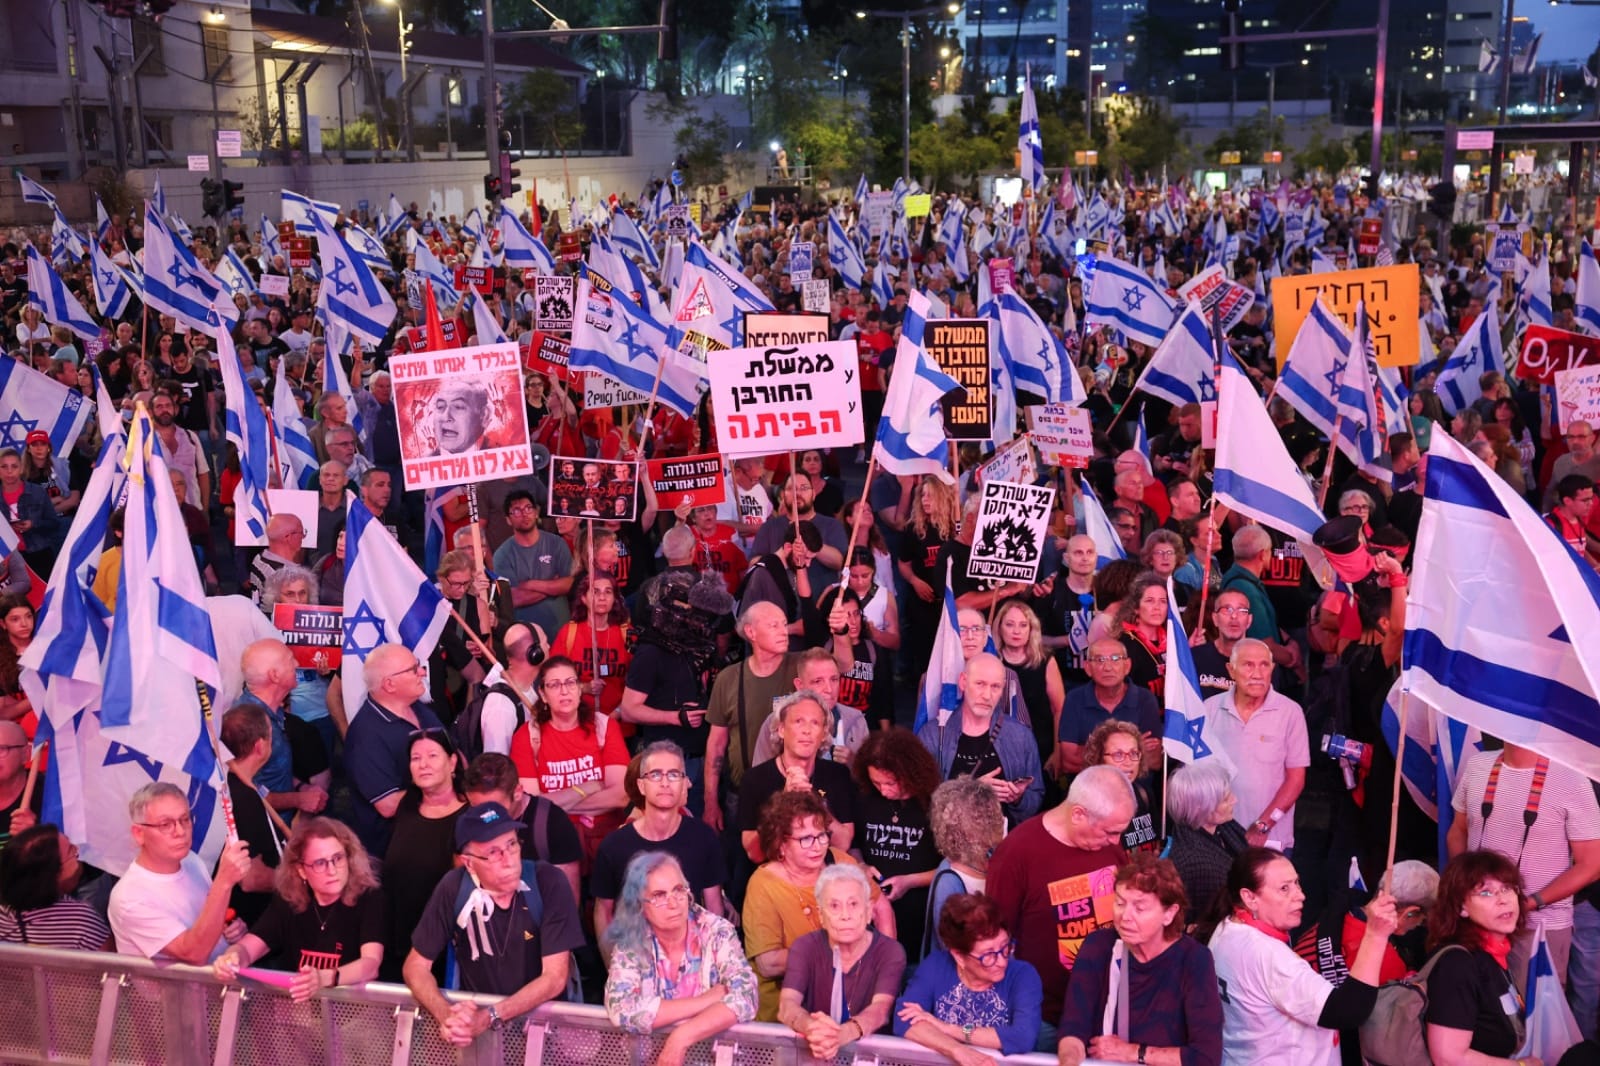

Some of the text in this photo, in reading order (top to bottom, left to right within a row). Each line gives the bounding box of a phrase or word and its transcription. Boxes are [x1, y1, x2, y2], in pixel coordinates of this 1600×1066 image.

[556, 287, 571, 295] לא
[562, 278, 572, 286] מי
[934, 326, 986, 345] ממשלת
[393, 350, 517, 379] בגללך אנחנו מתים
[744, 347, 834, 378] ממשלת
[948, 347, 986, 366] חורבן
[1523, 337, 1560, 379] Oy
[967, 386, 987, 404] את
[951, 406, 987, 424] העם!
[405, 449, 529, 485] צא לנו מהחיים
[664, 460, 719, 478] תהיו גולדה.
[653, 476, 717, 492] קחו אחריות!
[986, 483, 1051, 505] מי שהרס
[983, 499, 1048, 520] לא יתקן
[1003, 565, 1033, 579] בחירות
[295, 612, 335, 629] גולדה.
[578, 755, 594, 770] לא
[566, 767, 602, 787] הביתה
[871, 848, 911, 861] באוקטובר
[1050, 877, 1091, 903] HERE
[1057, 898, 1091, 921] LIES
[1057, 917, 1097, 938] LOVE
